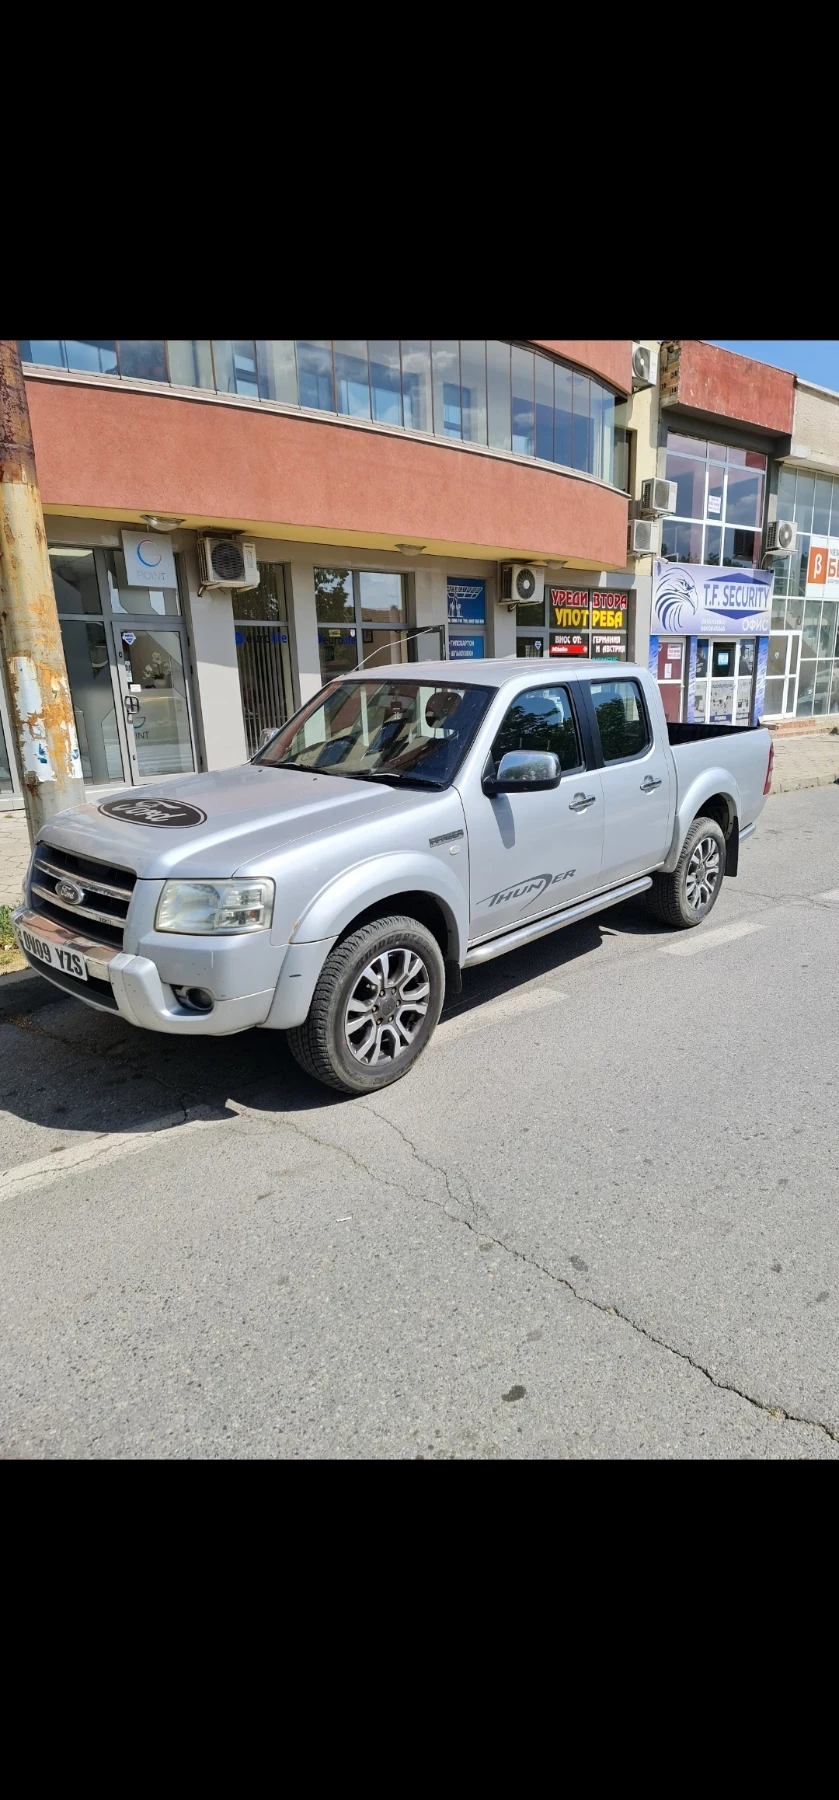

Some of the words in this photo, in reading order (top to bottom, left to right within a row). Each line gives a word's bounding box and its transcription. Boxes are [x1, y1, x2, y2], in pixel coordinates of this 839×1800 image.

[137, 570, 166, 581] POINT
[551, 589, 588, 607] УРЕДИ
[592, 591, 628, 610] ВТОРА
[703, 583, 721, 606] T.F.
[722, 585, 771, 608] SECURITY
[741, 619, 769, 632] ОФИС
[554, 635, 571, 644] ВНОС
[572, 635, 582, 644] ОТ:
[592, 635, 621, 644] ГЕРМАНИЯ
[595, 645, 601, 653] И
[602, 645, 626, 653] АВСТРИЯ
[111, 800, 187, 822] Ford
[60, 884, 76, 900] Ford
[54, 947, 84, 977] YZS
